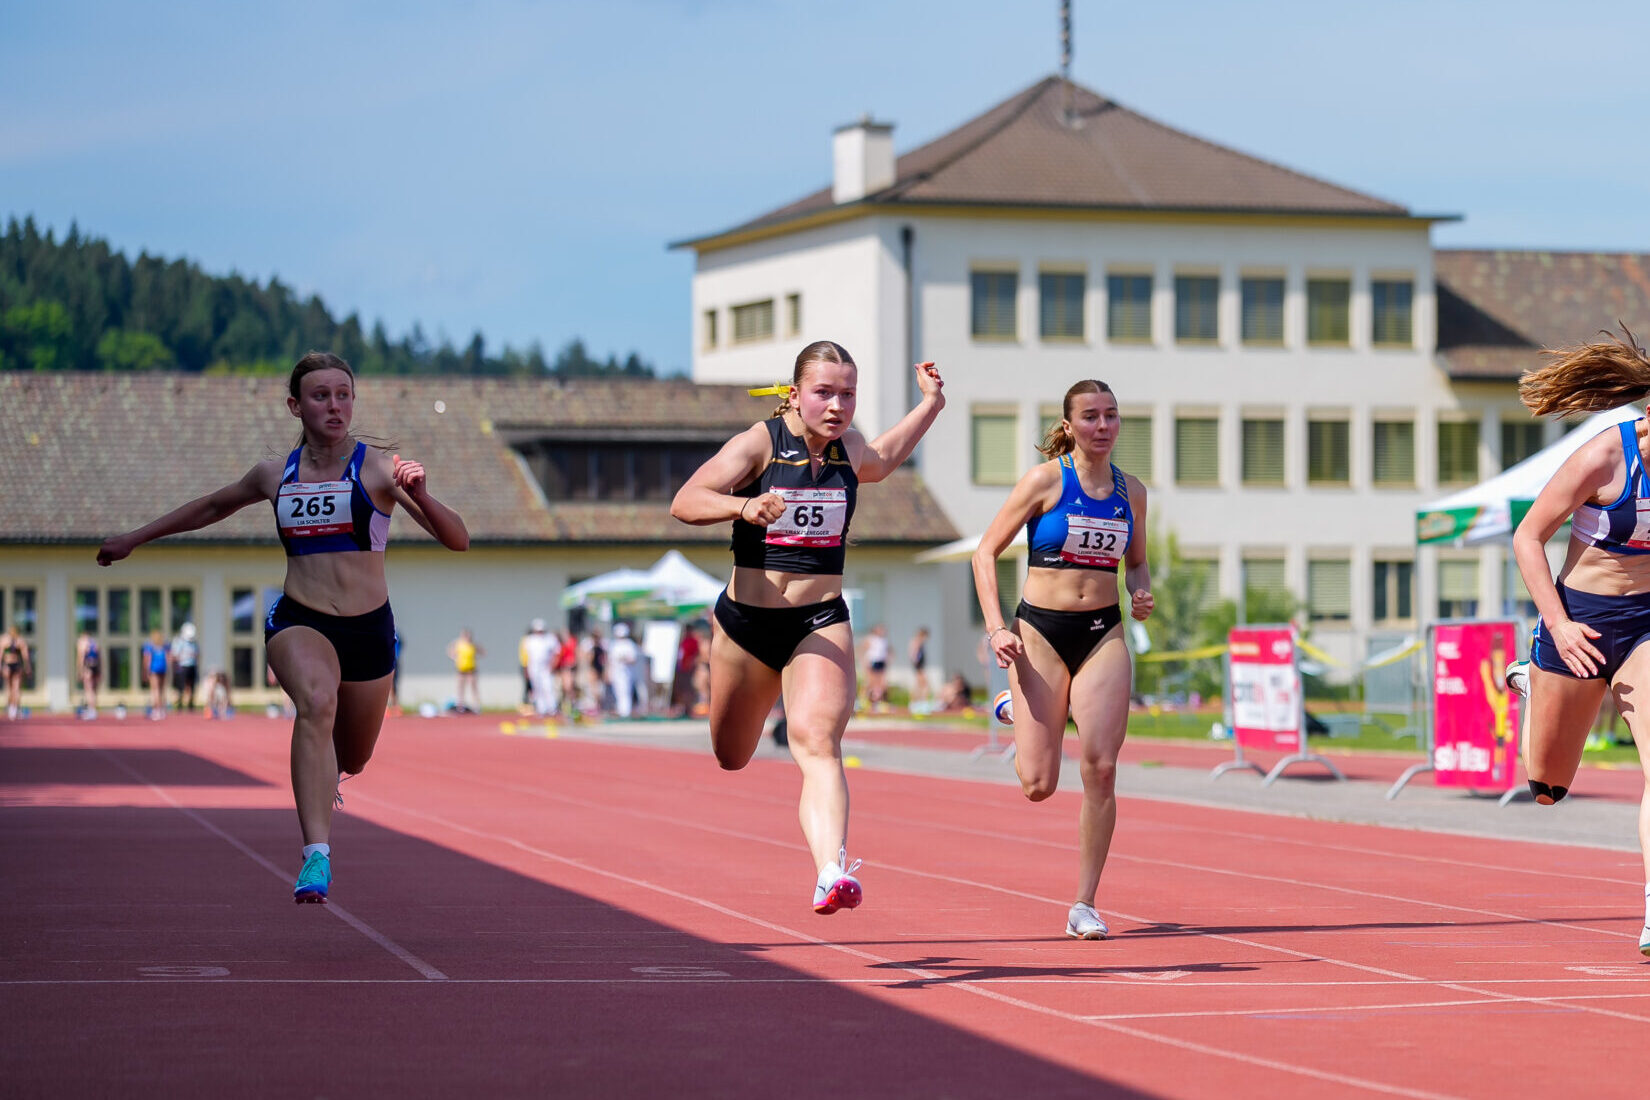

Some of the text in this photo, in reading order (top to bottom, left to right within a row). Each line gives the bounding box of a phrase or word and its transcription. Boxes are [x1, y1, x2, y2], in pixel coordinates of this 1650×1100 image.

[291, 495, 335, 518] 265
[794, 505, 824, 528] 65
[1078, 531, 1117, 552] 132
